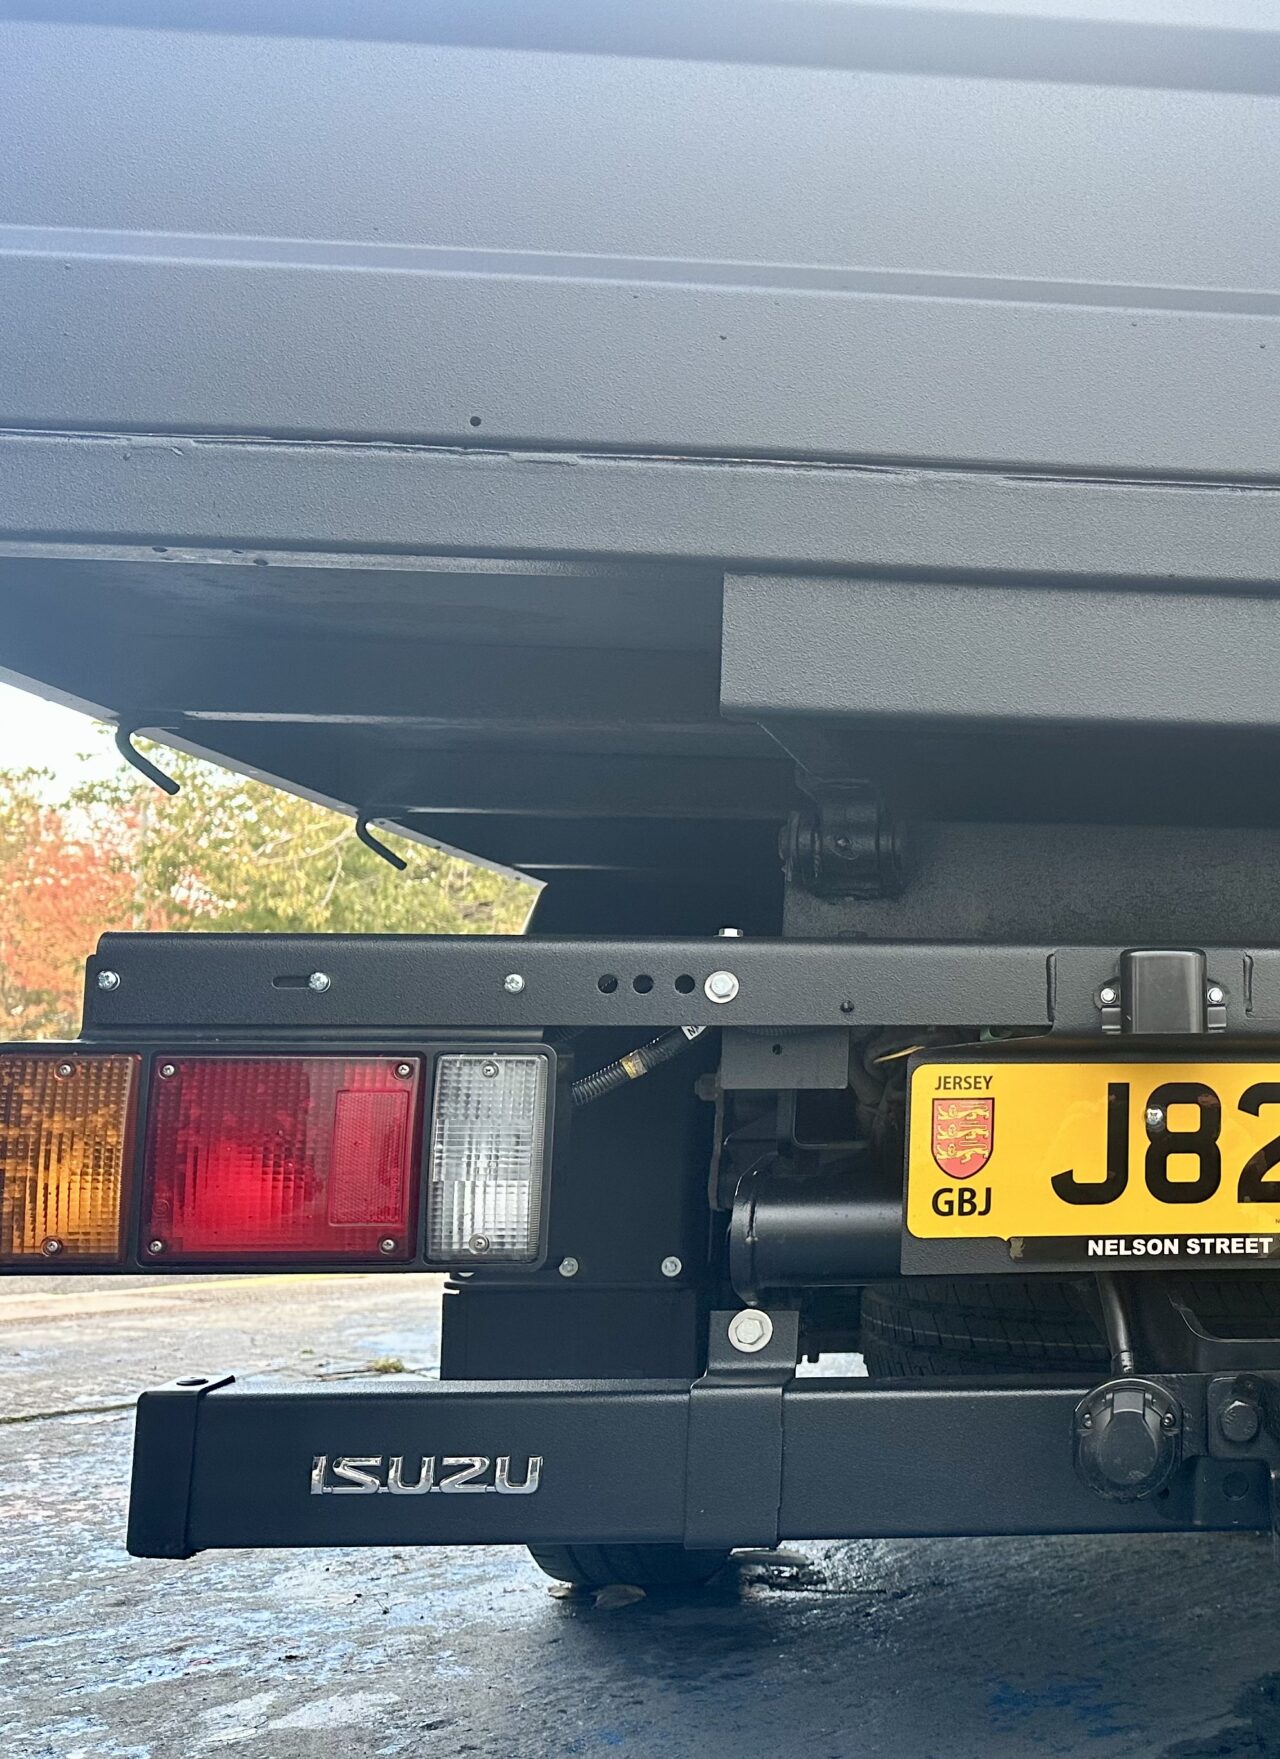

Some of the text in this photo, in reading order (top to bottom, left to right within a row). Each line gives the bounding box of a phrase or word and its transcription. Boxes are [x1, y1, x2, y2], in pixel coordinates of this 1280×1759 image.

[935, 1075, 993, 1090] JERSEY
[931, 1186, 993, 1217] GBJ
[1087, 1238, 1179, 1256] NELSON
[1186, 1237, 1273, 1255] STREET
[310, 1455, 544, 1495] ISUZU
